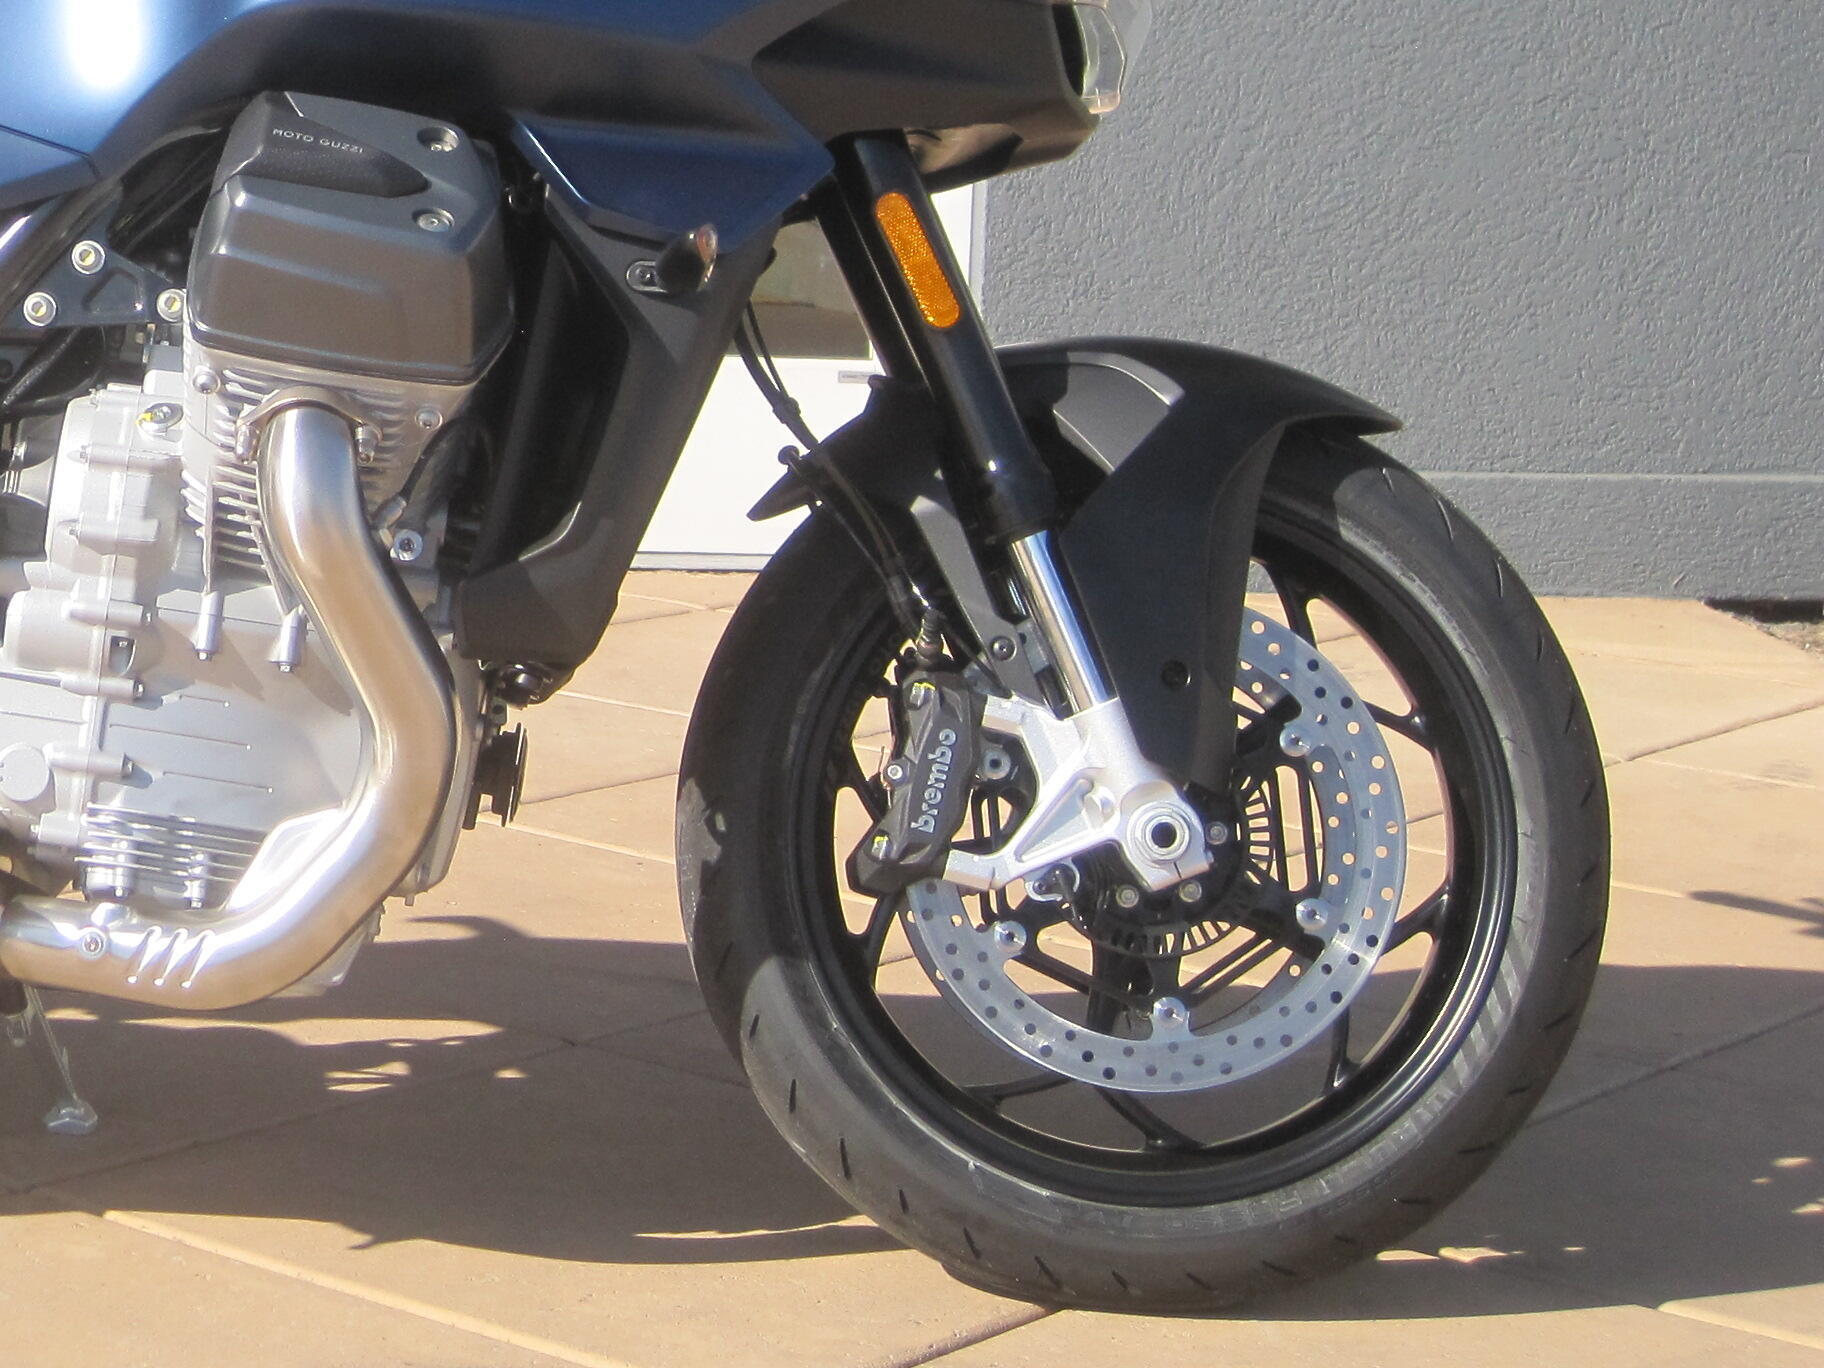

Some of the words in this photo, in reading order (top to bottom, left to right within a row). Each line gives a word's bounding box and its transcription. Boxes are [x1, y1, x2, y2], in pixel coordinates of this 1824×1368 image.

[272, 128, 314, 142] MOTO
[319, 138, 364, 153] GUZZI
[910, 728, 957, 834] brembo
